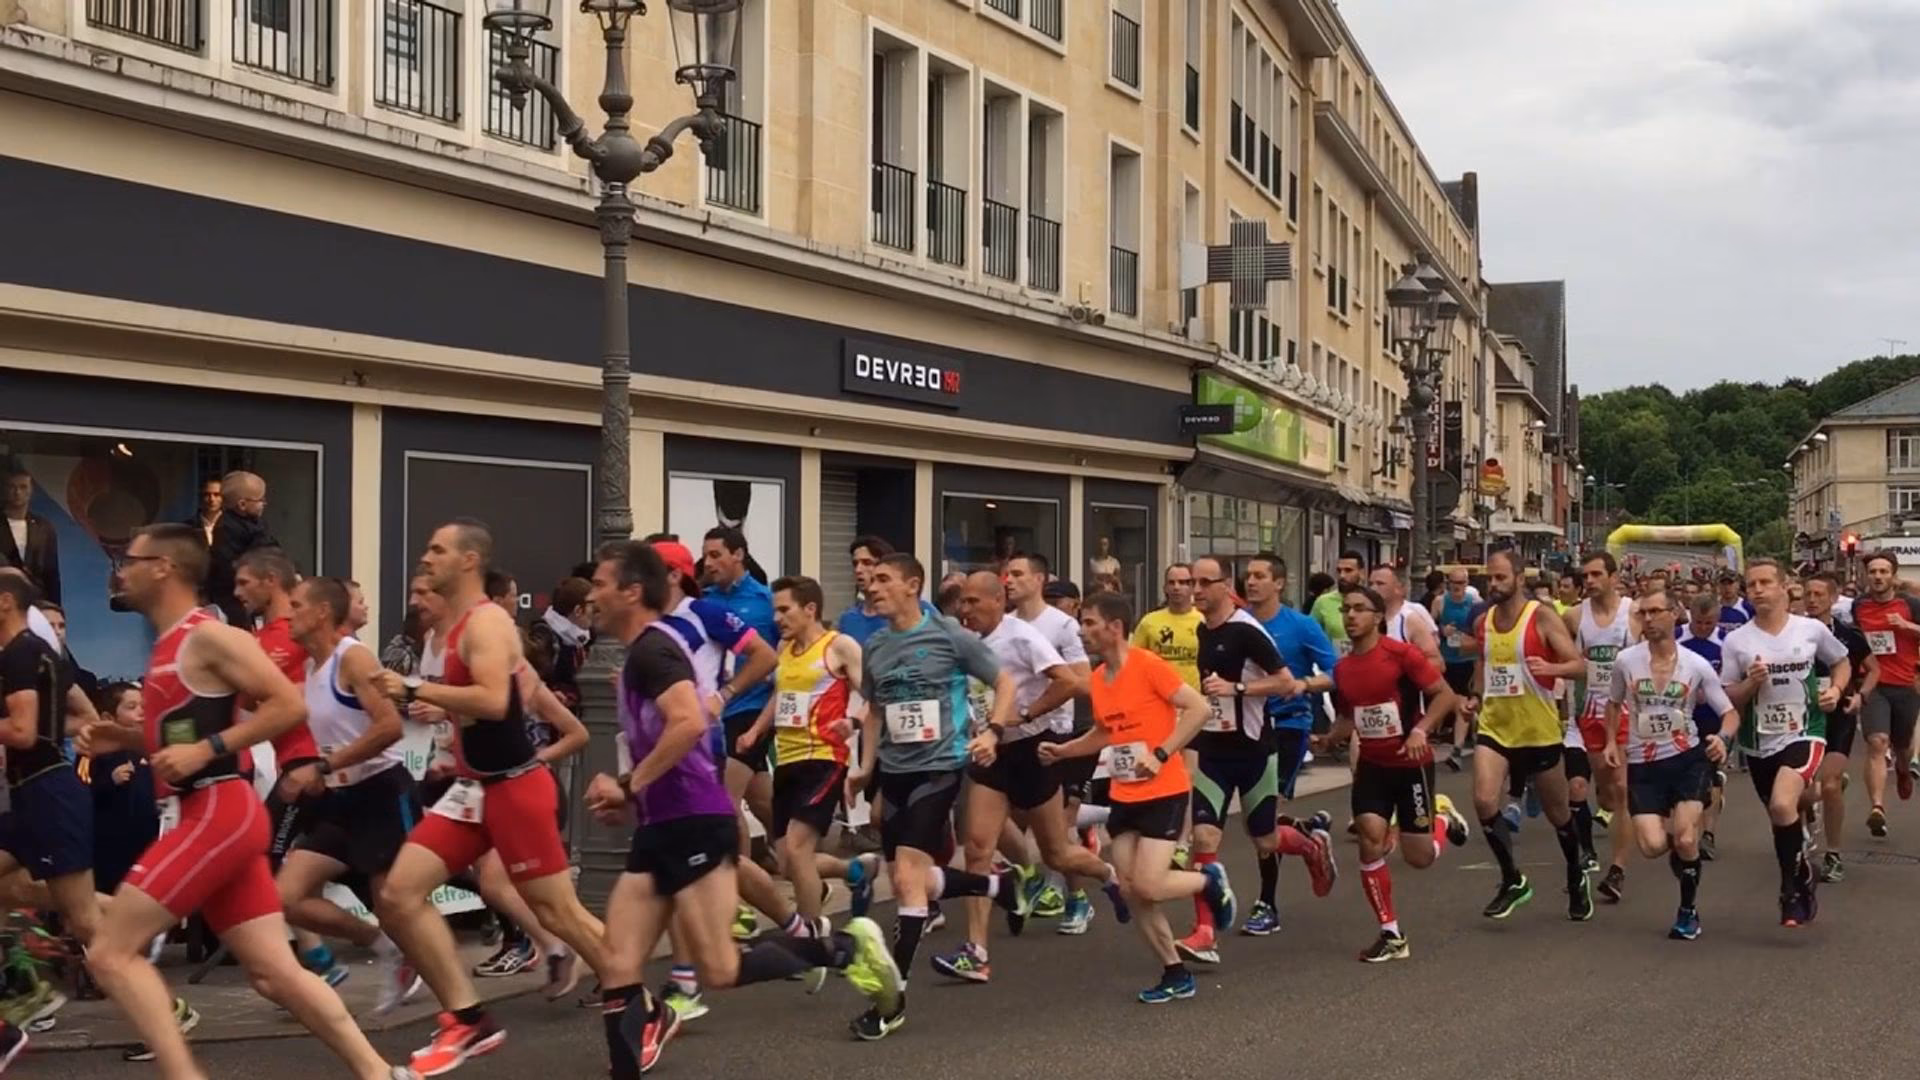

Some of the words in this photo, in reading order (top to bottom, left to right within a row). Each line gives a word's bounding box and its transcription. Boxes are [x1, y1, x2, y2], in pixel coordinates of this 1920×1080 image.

[899, 714, 925, 729] 731
[1362, 714, 1391, 728] 1062
[1764, 711, 1795, 724] 1421
[1650, 721, 1673, 733] 137
